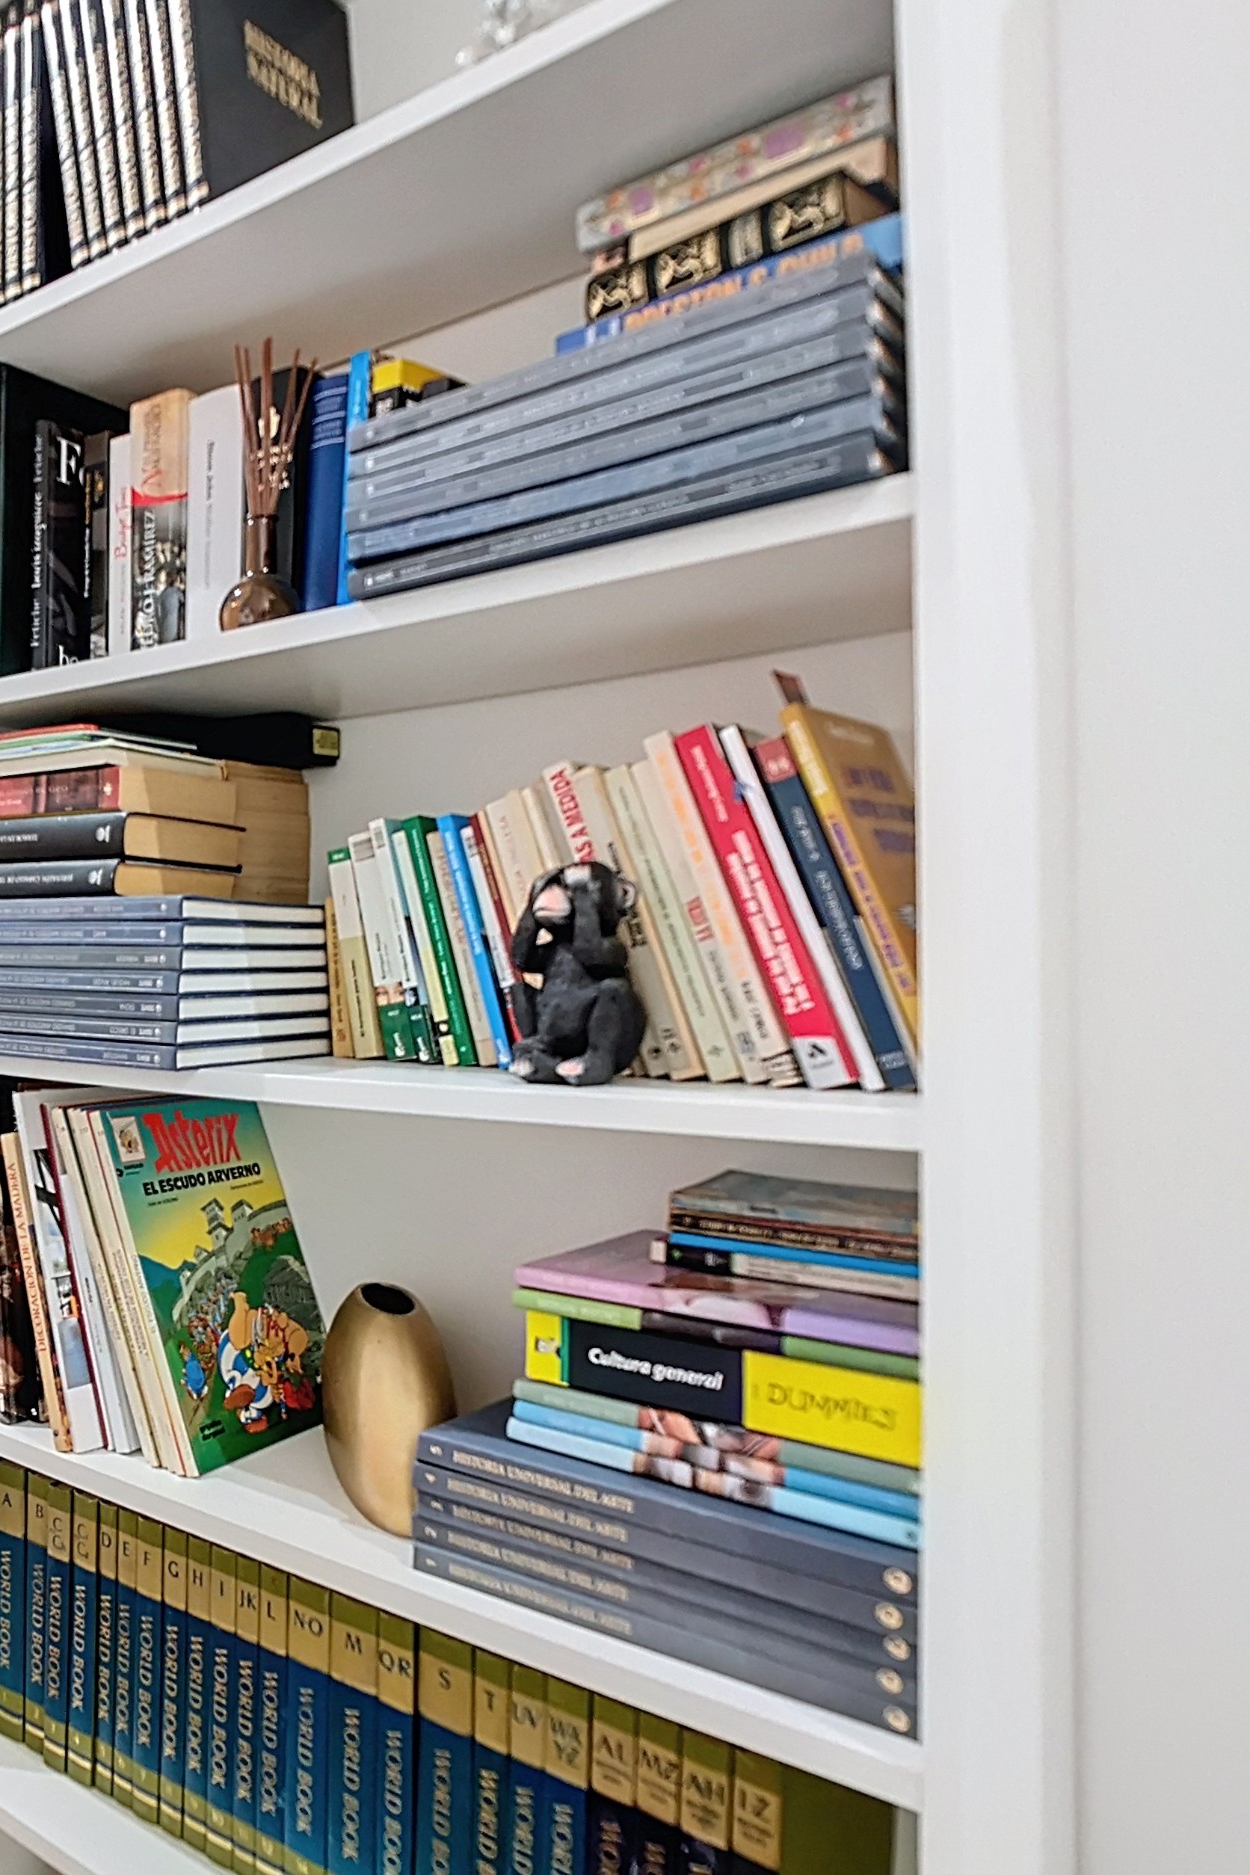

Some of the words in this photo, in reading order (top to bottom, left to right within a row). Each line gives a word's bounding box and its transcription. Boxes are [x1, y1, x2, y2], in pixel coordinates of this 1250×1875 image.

[7, 1162, 24, 1218] MADERA
[142, 1182, 159, 1196] EL
[158, 1172, 206, 1193] ESCUDO
[207, 1162, 261, 1185] ARVERNO
[588, 1346, 651, 1377] Cultura
[652, 1364, 724, 1392] general
[768, 1382, 897, 1432] DUMMIES
[2, 1492, 12, 1508] A
[35, 1504, 43, 1519] B
[452, 1450, 506, 1476] HISTORIA
[506, 1465, 572, 1494] UNIVERSAL
[572, 1484, 598, 1504] DEL
[600, 1493, 634, 1514] ARTE
[102, 1532, 112, 1548] D
[123, 1542, 130, 1557] E
[144, 1552, 151, 1566] F
[168, 1561, 179, 1578] G
[0, 1550, 12, 1614] WORLD
[32, 1564, 44, 1628] WORLD
[50, 1576, 62, 1642] WORLD
[193, 1568, 203, 1587] H
[74, 1585, 86, 1652] WORLD
[99, 1595, 111, 1663] WORLD
[118, 1604, 130, 1673] WORLD
[267, 1601, 276, 1621] L
[0, 1616, 11, 1670] BOOK
[31, 1631, 43, 1686] BOOK
[48, 1645, 60, 1700] BOOK
[138, 1615, 153, 1687] WORLD
[165, 1625, 179, 1698] WORLD
[189, 1636, 204, 1710] WORLD
[346, 1632, 362, 1655] M
[72, 1654, 84, 1712] BOOK
[98, 1665, 110, 1724] BOOK
[116, 1676, 129, 1736] BOOK
[213, 1648, 228, 1723] WORLD
[238, 1660, 253, 1737] WORLD
[438, 1666, 451, 1690] S
[484, 1690, 494, 1713] T
[138, 1688, 151, 1749] BOOK
[163, 1698, 177, 1761] BOOK
[263, 1671, 279, 1749] WORLD
[298, 1687, 314, 1767] WORLD
[188, 1711, 202, 1774] BOOK
[211, 1724, 227, 1789] BOOK
[237, 1737, 252, 1803] BOOK
[343, 1707, 361, 1792] WORLD
[384, 1729, 403, 1816] WORLD
[261, 1750, 277, 1817] BOOK
[296, 1768, 313, 1836] BOOK
[433, 1748, 452, 1837] WORLD
[478, 1768, 500, 1860] WORLD
[342, 1792, 360, 1864] BOOK
